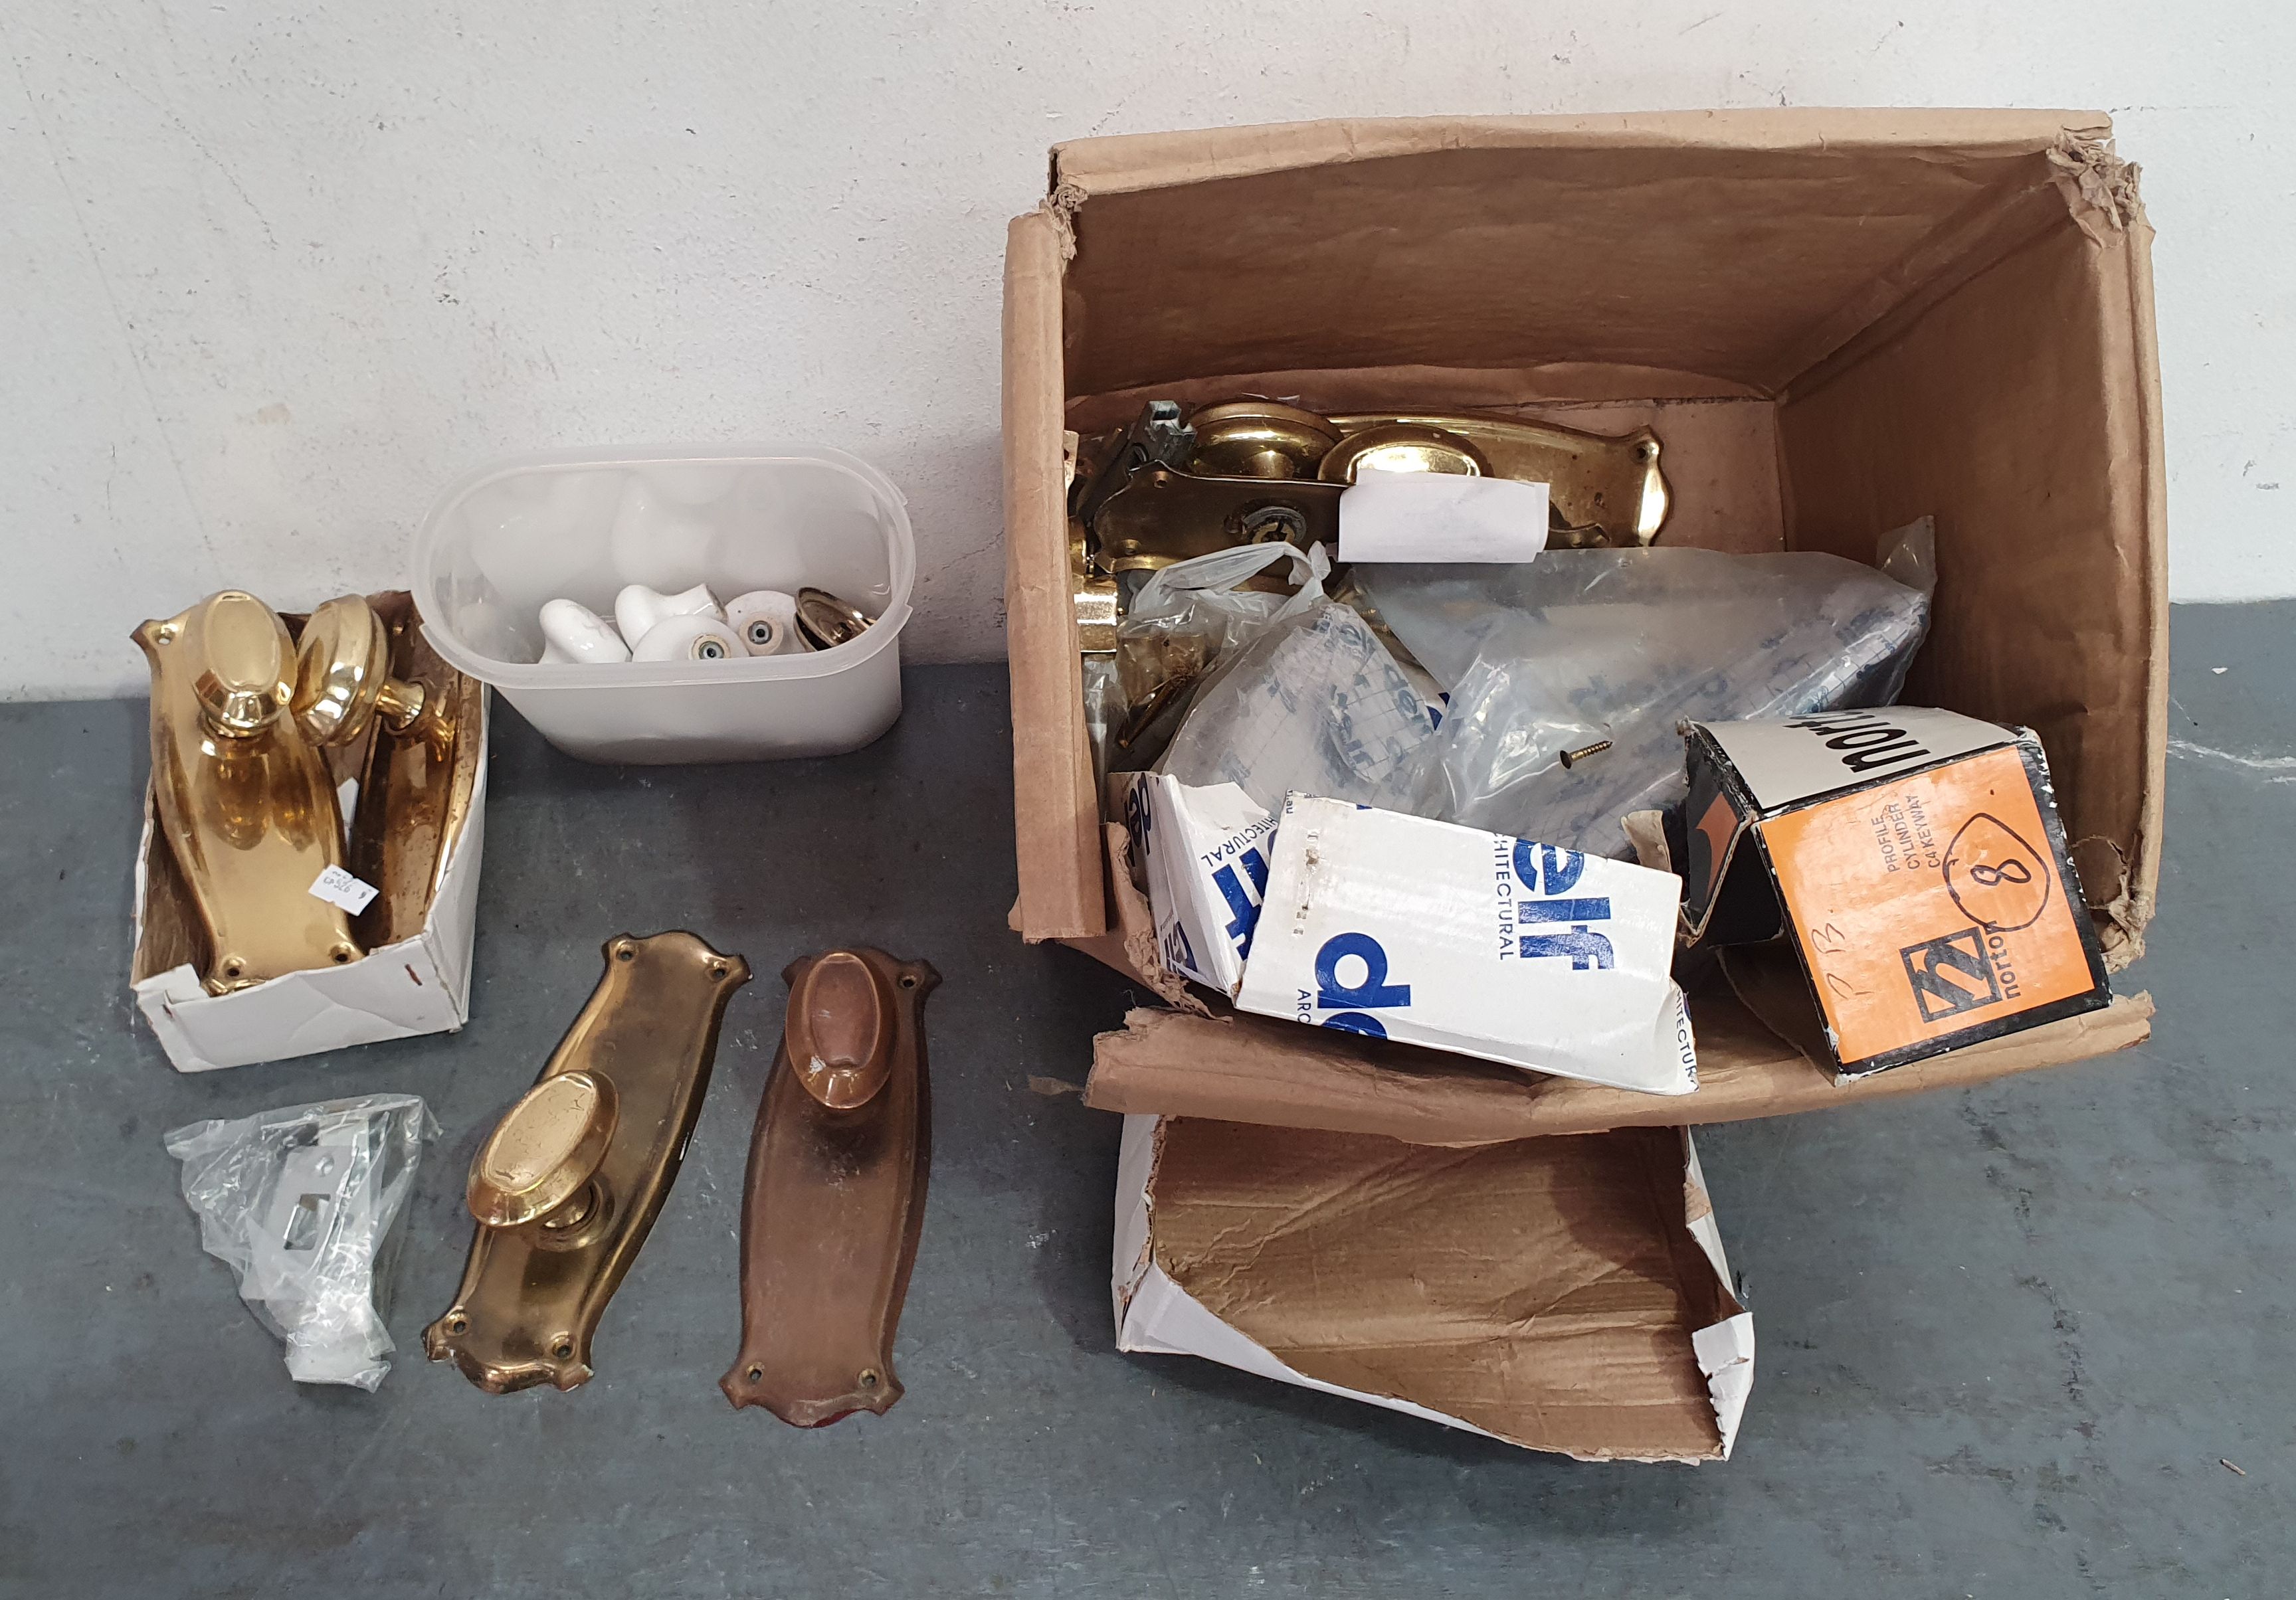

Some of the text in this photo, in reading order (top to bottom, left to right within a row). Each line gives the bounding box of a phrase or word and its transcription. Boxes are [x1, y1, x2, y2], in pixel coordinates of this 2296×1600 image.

[1871, 816, 1900, 872] PROFILE
[1888, 803, 1921, 869] CYLINDER
[1905, 796, 1941, 868] C4 KEYWAY
[1970, 859, 2032, 887] 8
[1985, 921, 2021, 1000] norton
